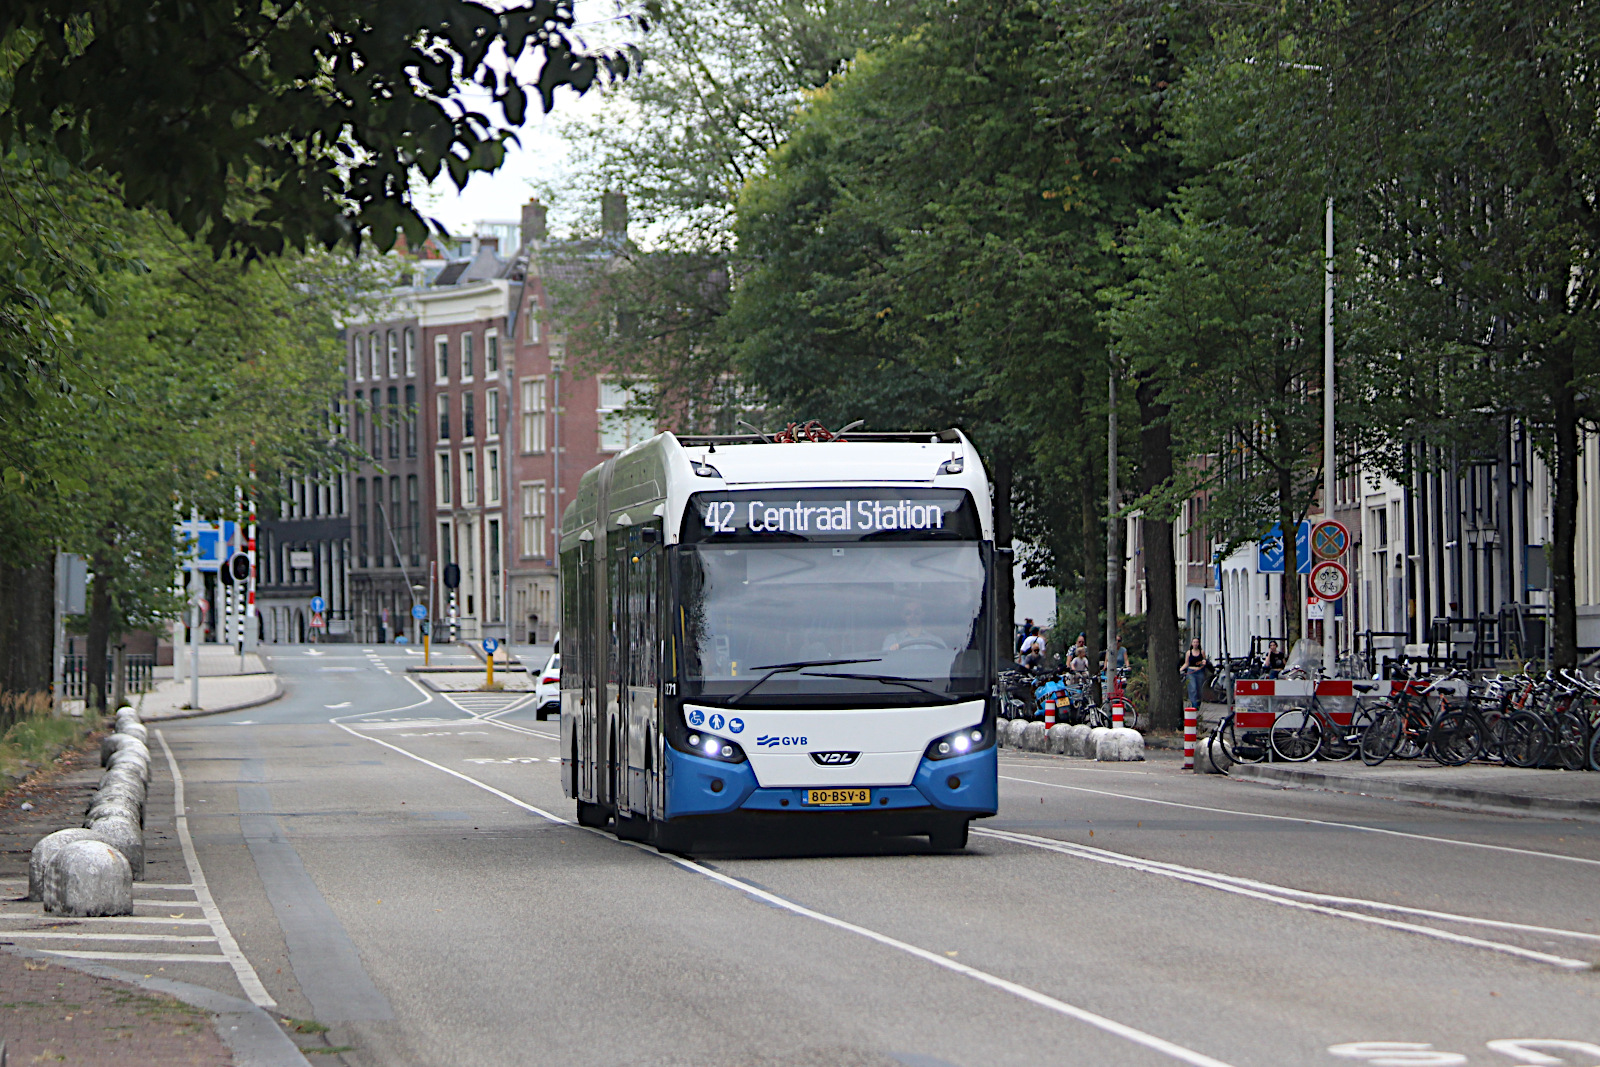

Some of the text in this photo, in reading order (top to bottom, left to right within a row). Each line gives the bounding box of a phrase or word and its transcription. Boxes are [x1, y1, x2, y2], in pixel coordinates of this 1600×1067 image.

[705, 500, 942, 533] 42 Centraal Station
[781, 736, 808, 746] GVB
[817, 753, 852, 763] VDL
[811, 790, 867, 802] 80-BSV-8
